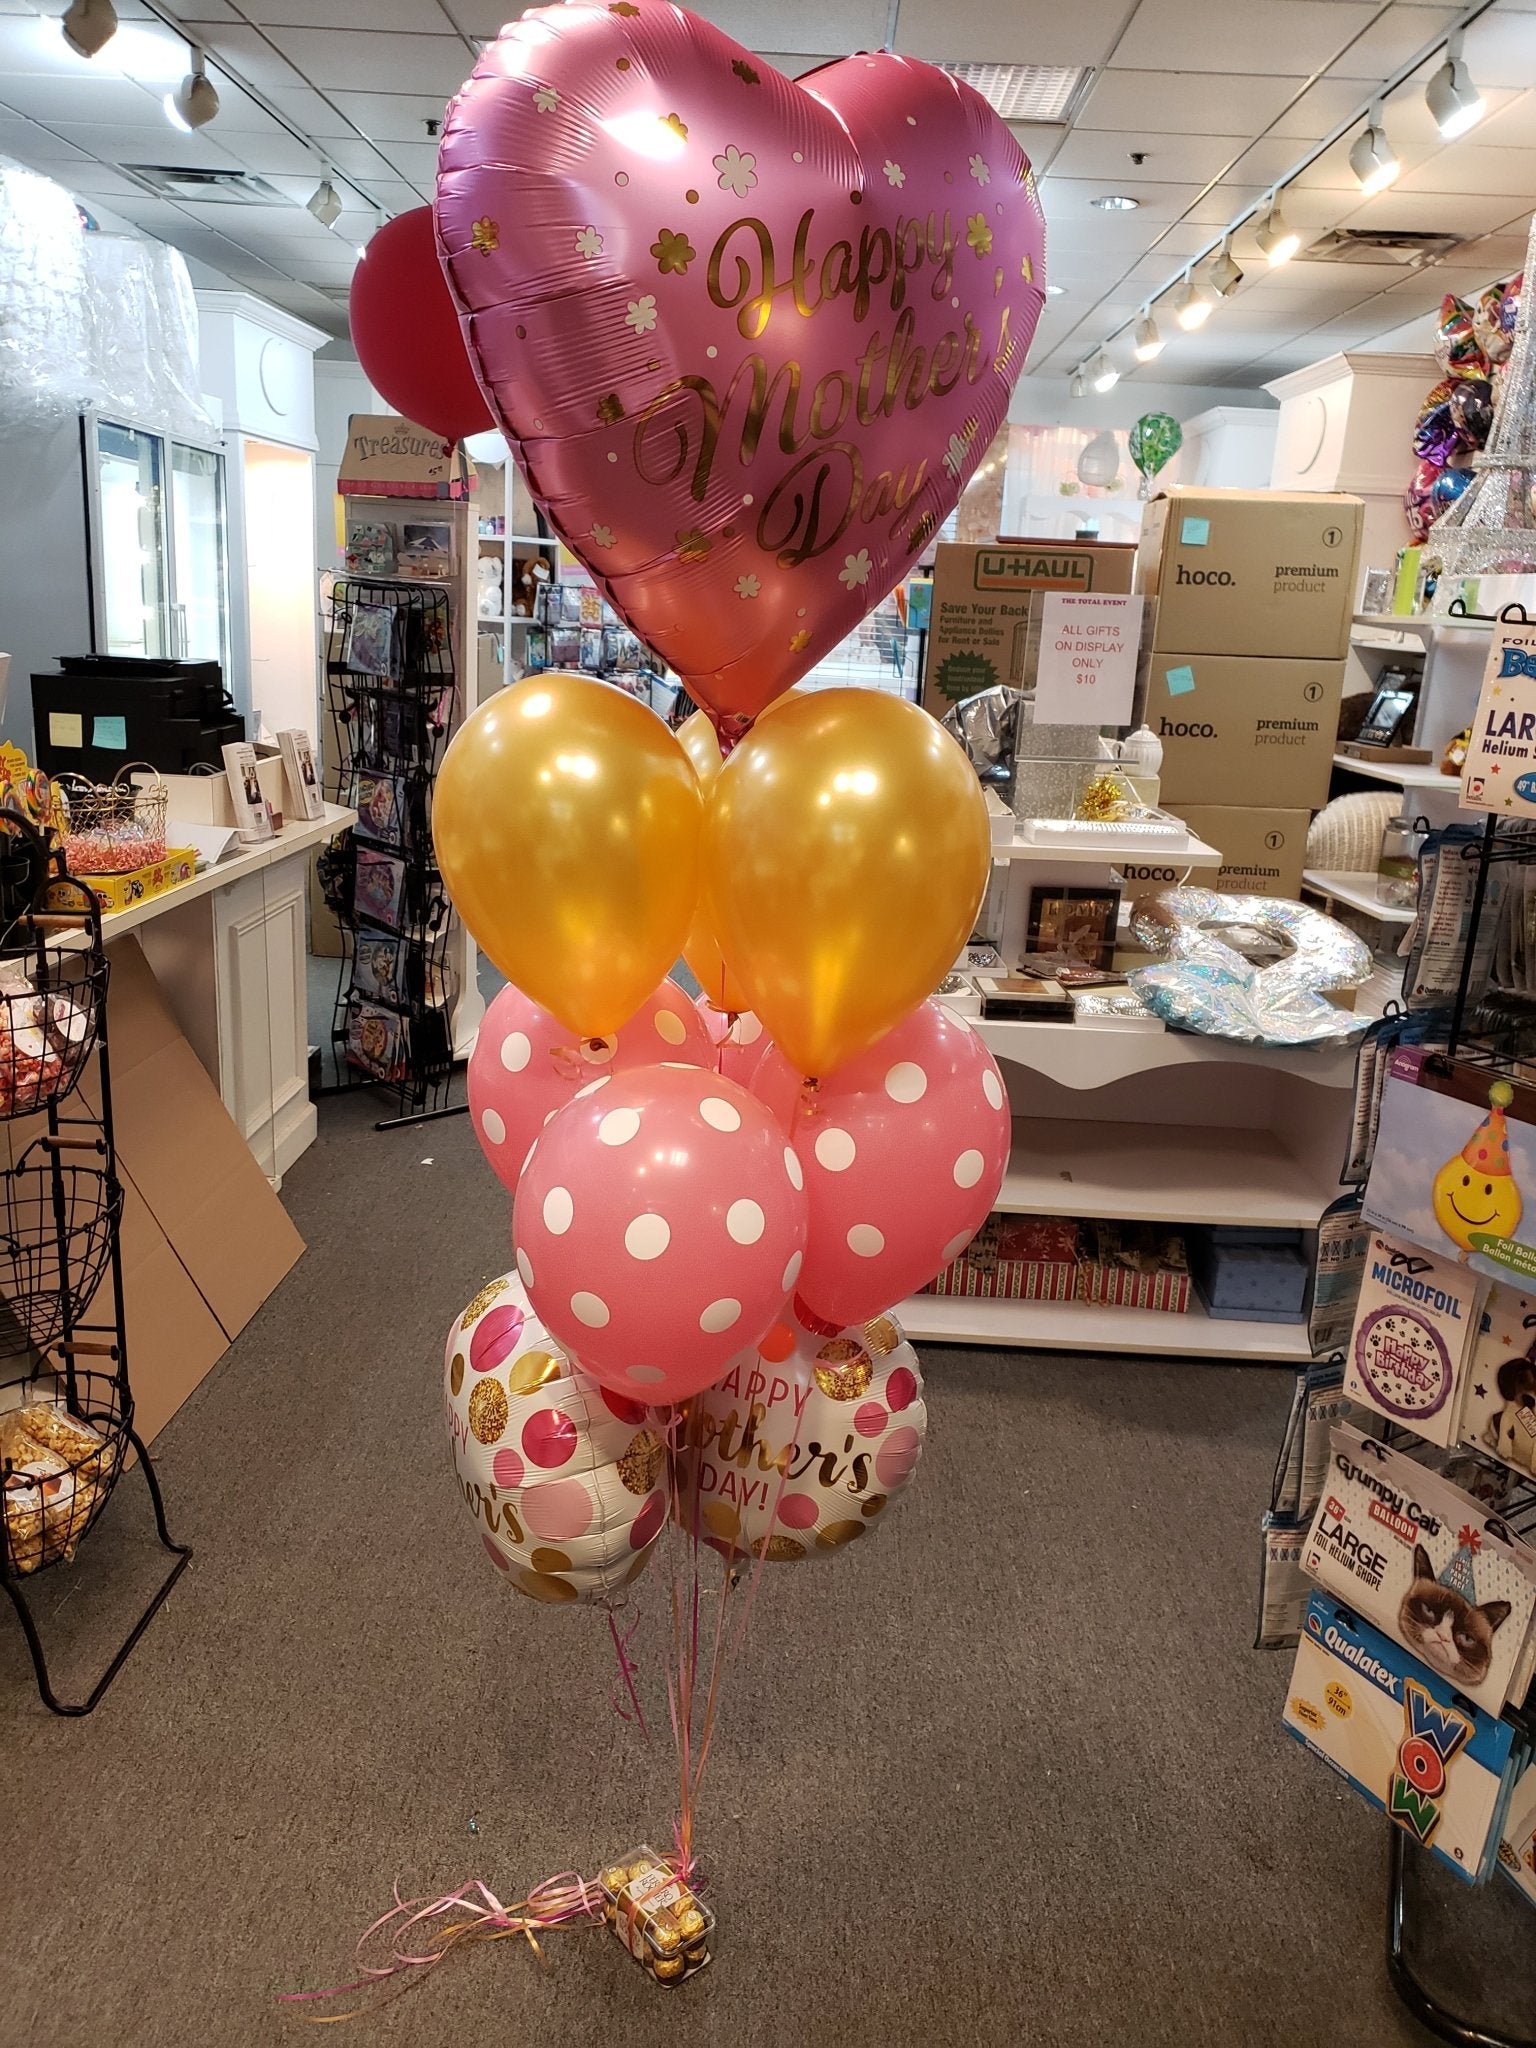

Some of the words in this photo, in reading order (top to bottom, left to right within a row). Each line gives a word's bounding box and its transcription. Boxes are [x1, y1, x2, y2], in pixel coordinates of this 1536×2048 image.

[707, 208, 960, 340] Happy
[633, 266, 1016, 501] Mother's
[353, 435, 446, 461] Treasures
[757, 441, 931, 569] Day
[983, 557, 1085, 578] U-HAUL
[1275, 564, 1339, 579] premium
[1273, 578, 1326, 594] product
[940, 602, 967, 614] Save
[971, 603, 996, 615] Your
[1000, 604, 1029, 617] Back
[939, 616, 976, 625] Furniture
[977, 616, 993, 625] and
[1062, 624, 1082, 635] ALL
[1086, 625, 1120, 636] GIFTS
[939, 625, 977, 636] Appliance
[979, 626, 1004, 636] Dollies
[938, 635, 950, 645] for
[951, 636, 970, 646] Rent
[972, 637, 981, 645] or
[982, 636, 1000, 646] Sale
[1055, 640, 1073, 651] ON
[1076, 641, 1124, 653] DISPLAY
[1072, 657, 1104, 668] ONLY
[1076, 673, 1096, 685] $10
[1256, 717, 1319, 732] premium
[1254, 731, 1306, 746] product
[1482, 739, 1528, 758] Helium
[1217, 864, 1280, 878] premium
[1216, 877, 1267, 891] product
[1482, 1243, 1511, 1263] Ballon
[1497, 1239, 1515, 1255] Foil
[1371, 1261, 1462, 1320] MICROFOIL
[1384, 1336, 1430, 1370] Happy
[1375, 1349, 1435, 1392] Birthday
[711, 1364, 813, 1418] APPY
[700, 1461, 769, 1511] DAY!
[1336, 1454, 1405, 1514] Grumpy
[1407, 1502, 1442, 1537] Cat
[1328, 1500, 1344, 1515] 36"
[1373, 1503, 1416, 1540] BALLOON
[1318, 1511, 1388, 1579] LARGE
[1313, 1530, 1329, 1552] FOIL
[1329, 1543, 1356, 1573] HELIUM
[1355, 1563, 1382, 1593] SHAPE
[1324, 1625, 1400, 1695] Qualatex
[1333, 1685, 1348, 1699] 36"
[1304, 1738, 1325, 1761] Special
[1390, 1686, 1467, 1842] WOW
